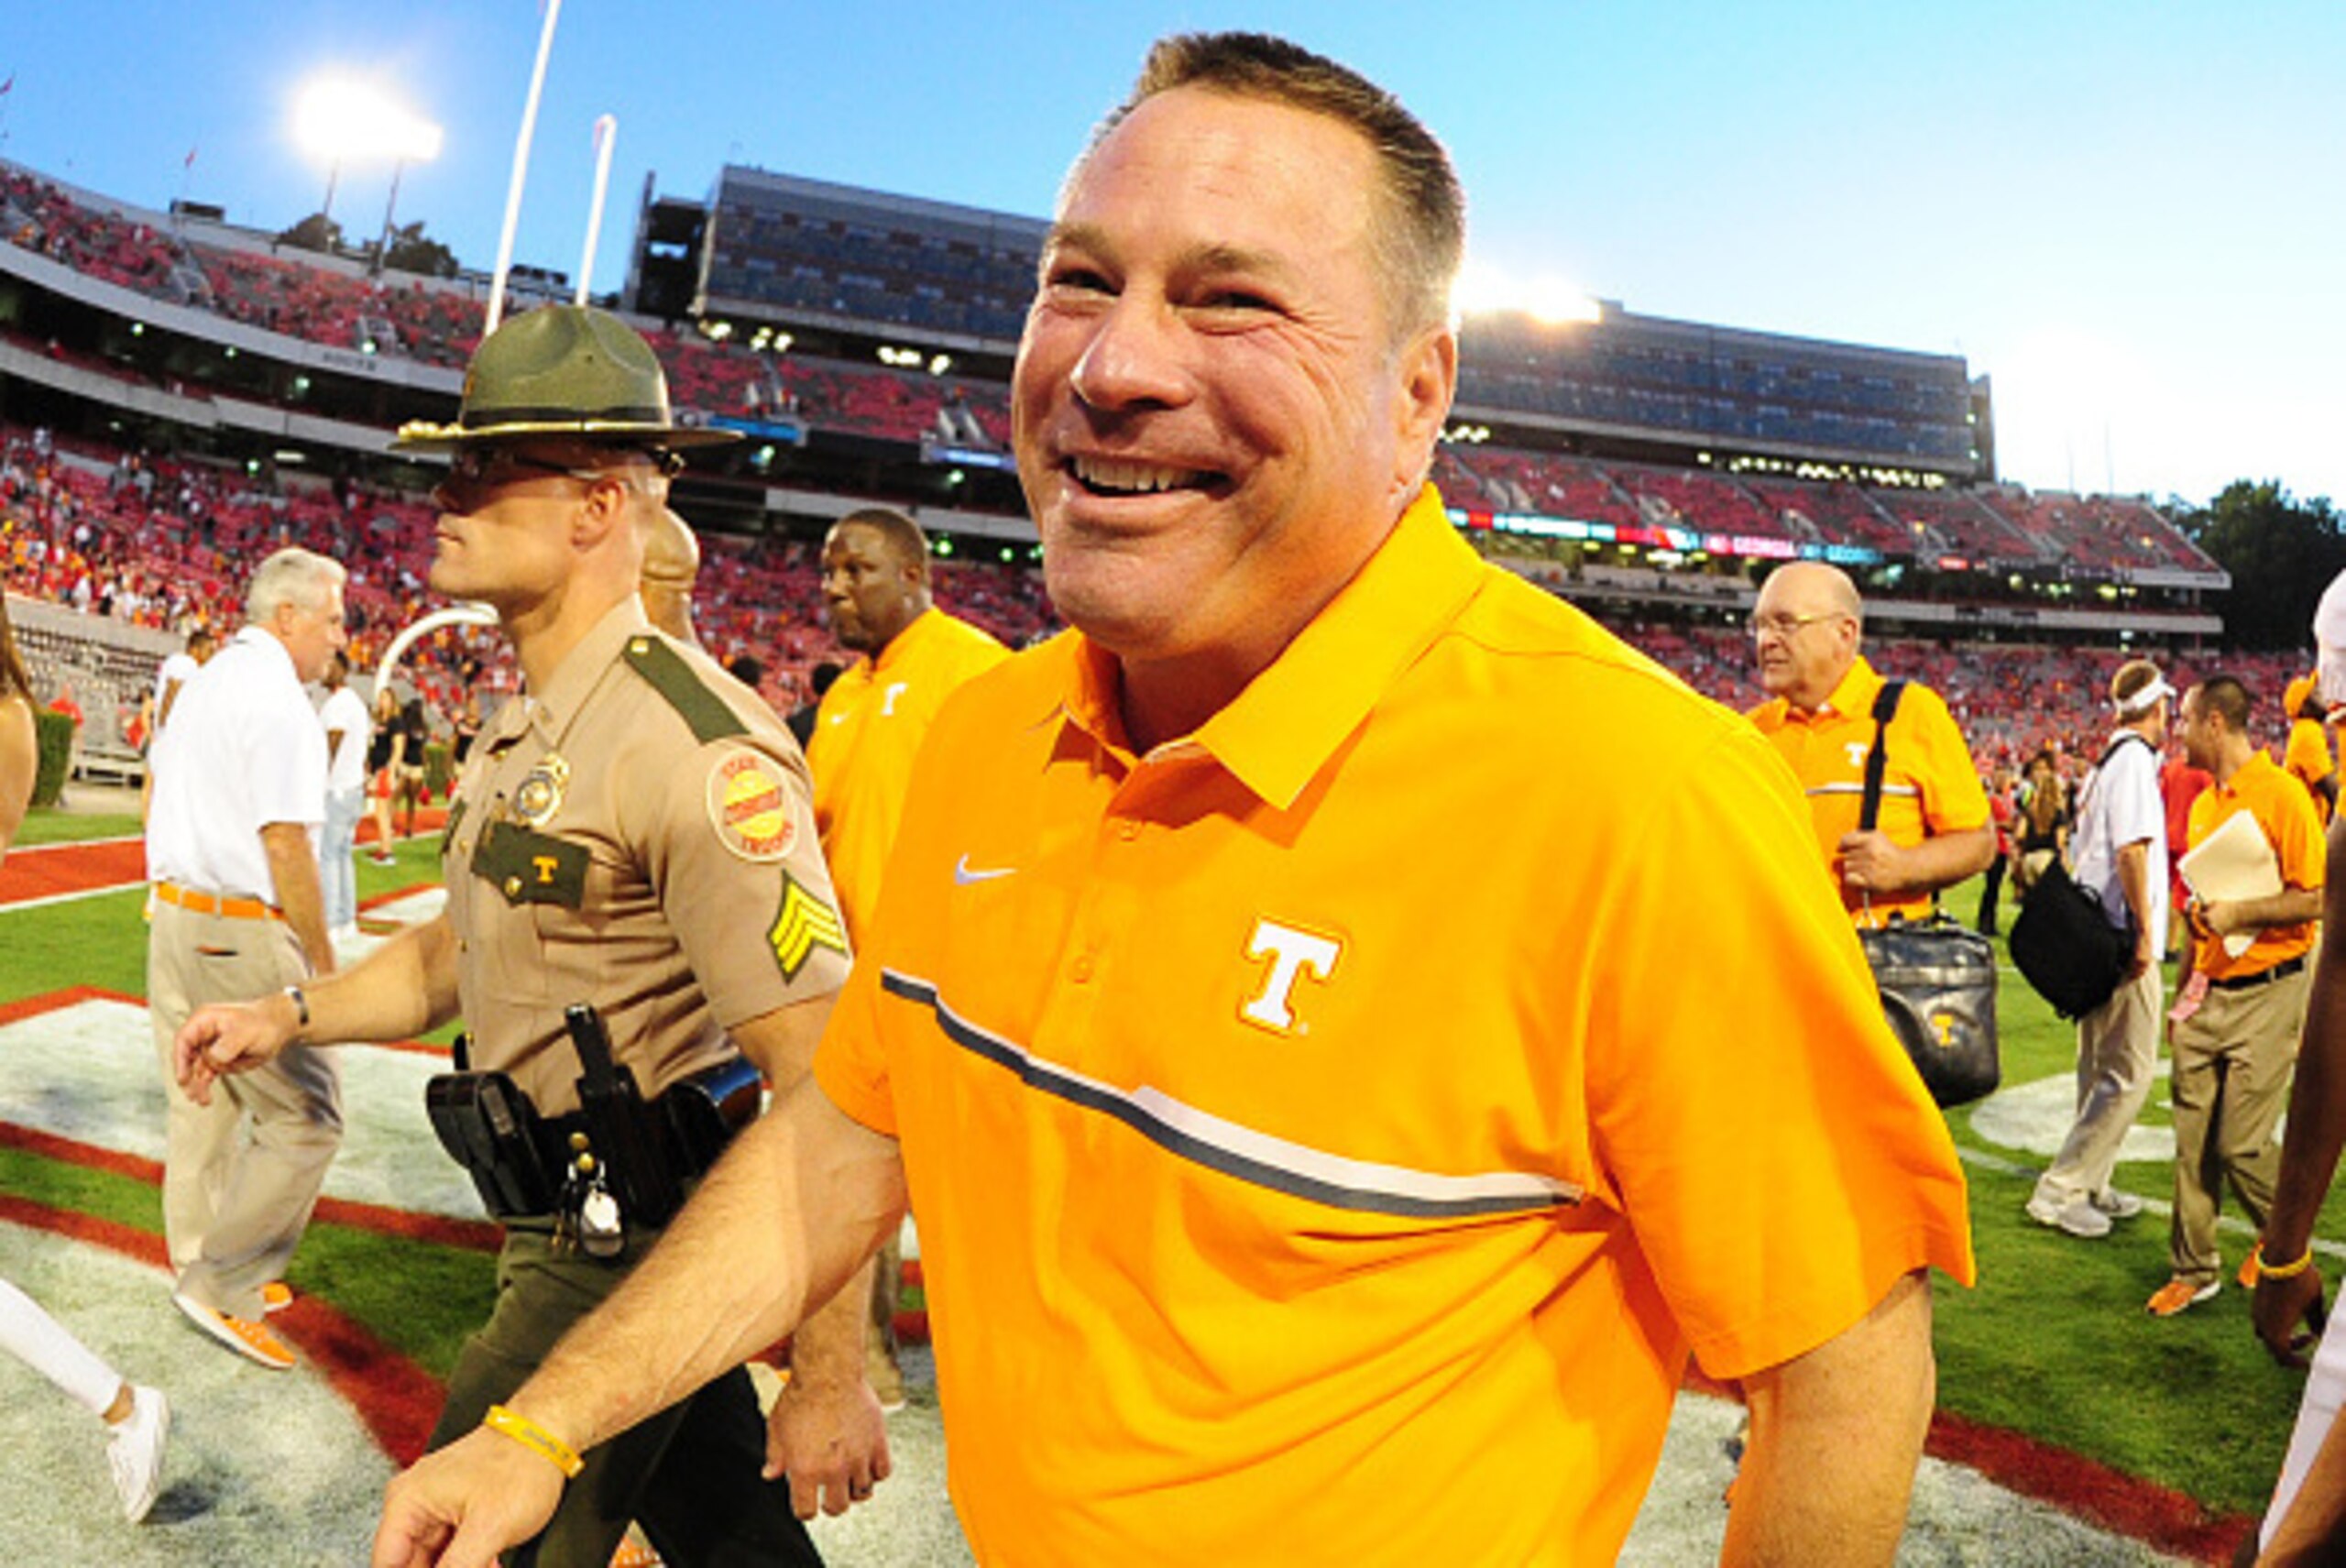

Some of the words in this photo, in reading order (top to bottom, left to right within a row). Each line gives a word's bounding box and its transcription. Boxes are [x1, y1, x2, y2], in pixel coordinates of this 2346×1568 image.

[1844, 741, 1869, 767] T
[532, 855, 558, 883] T
[1244, 920, 1341, 1028] T
[1932, 1013, 1953, 1047] T
